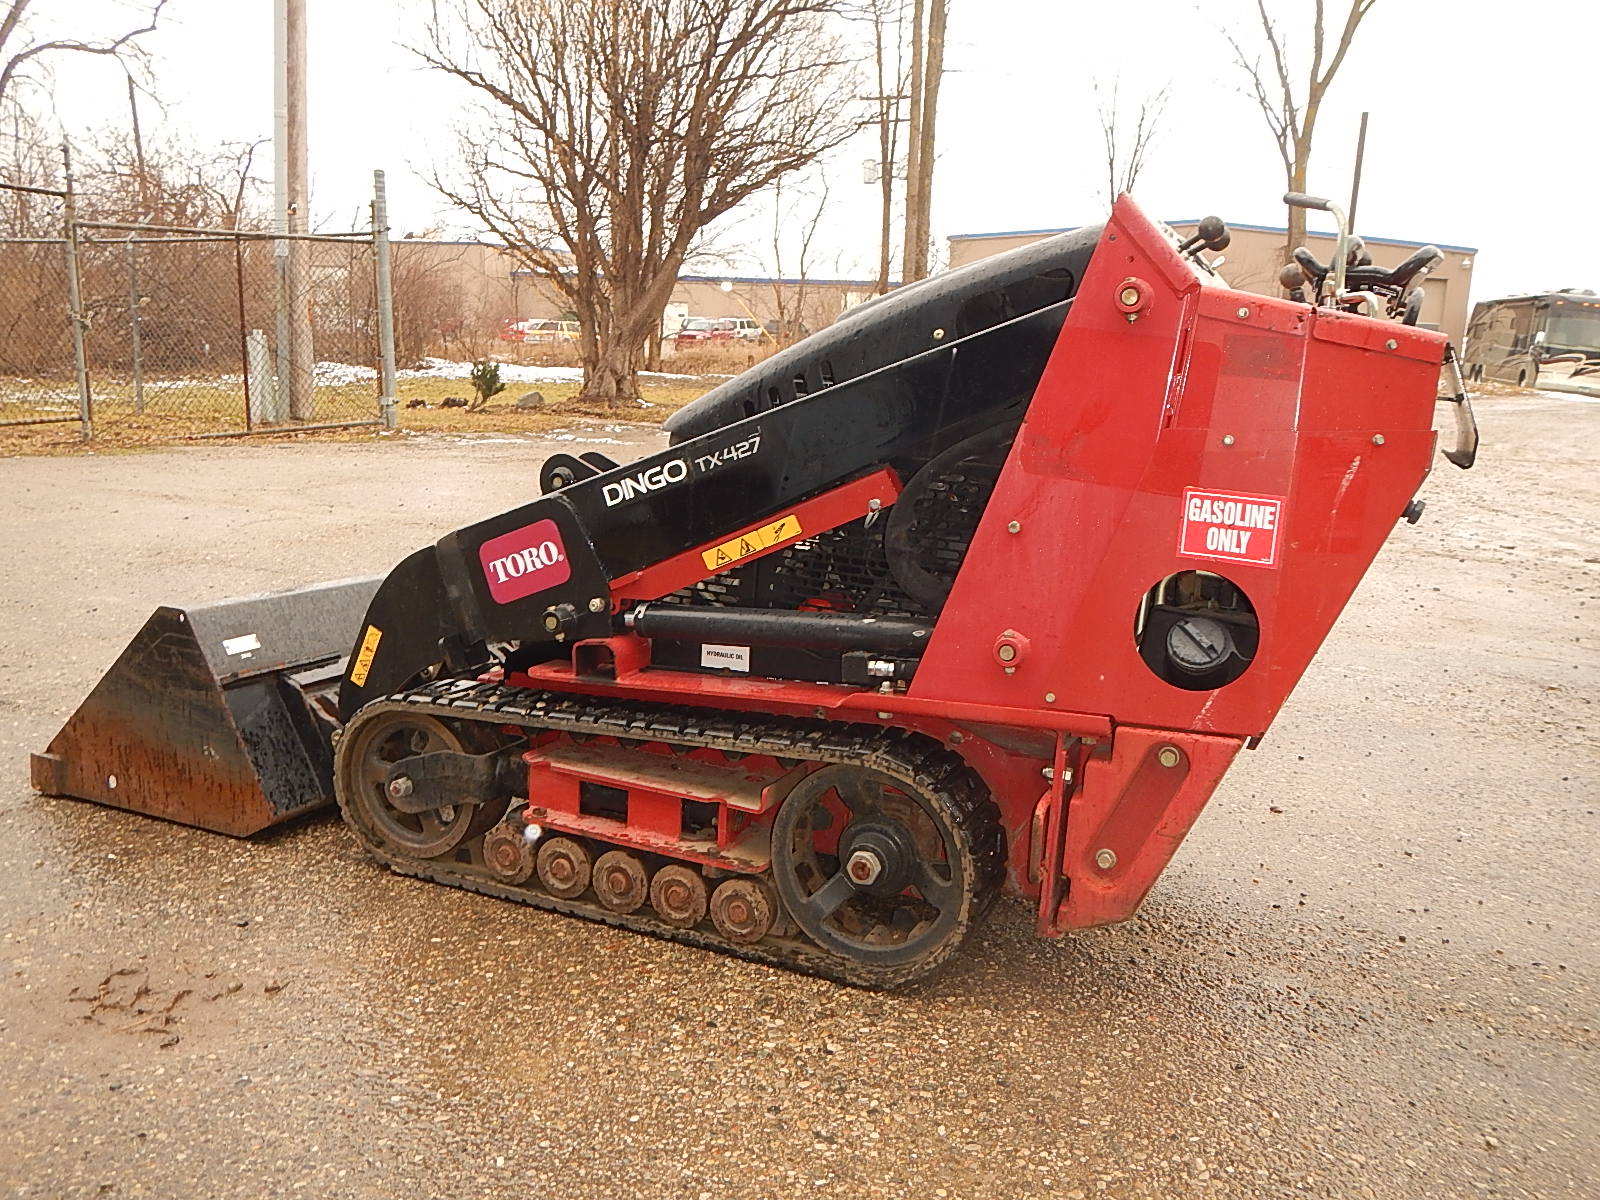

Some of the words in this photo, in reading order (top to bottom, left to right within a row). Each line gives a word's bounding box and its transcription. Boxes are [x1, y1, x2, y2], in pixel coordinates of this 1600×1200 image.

[601, 459, 688, 507] DINGO
[1188, 498, 1276, 530] GASOLINE
[1206, 527, 1252, 554] ONLY
[706, 650, 735, 659] HYDRAULIC
